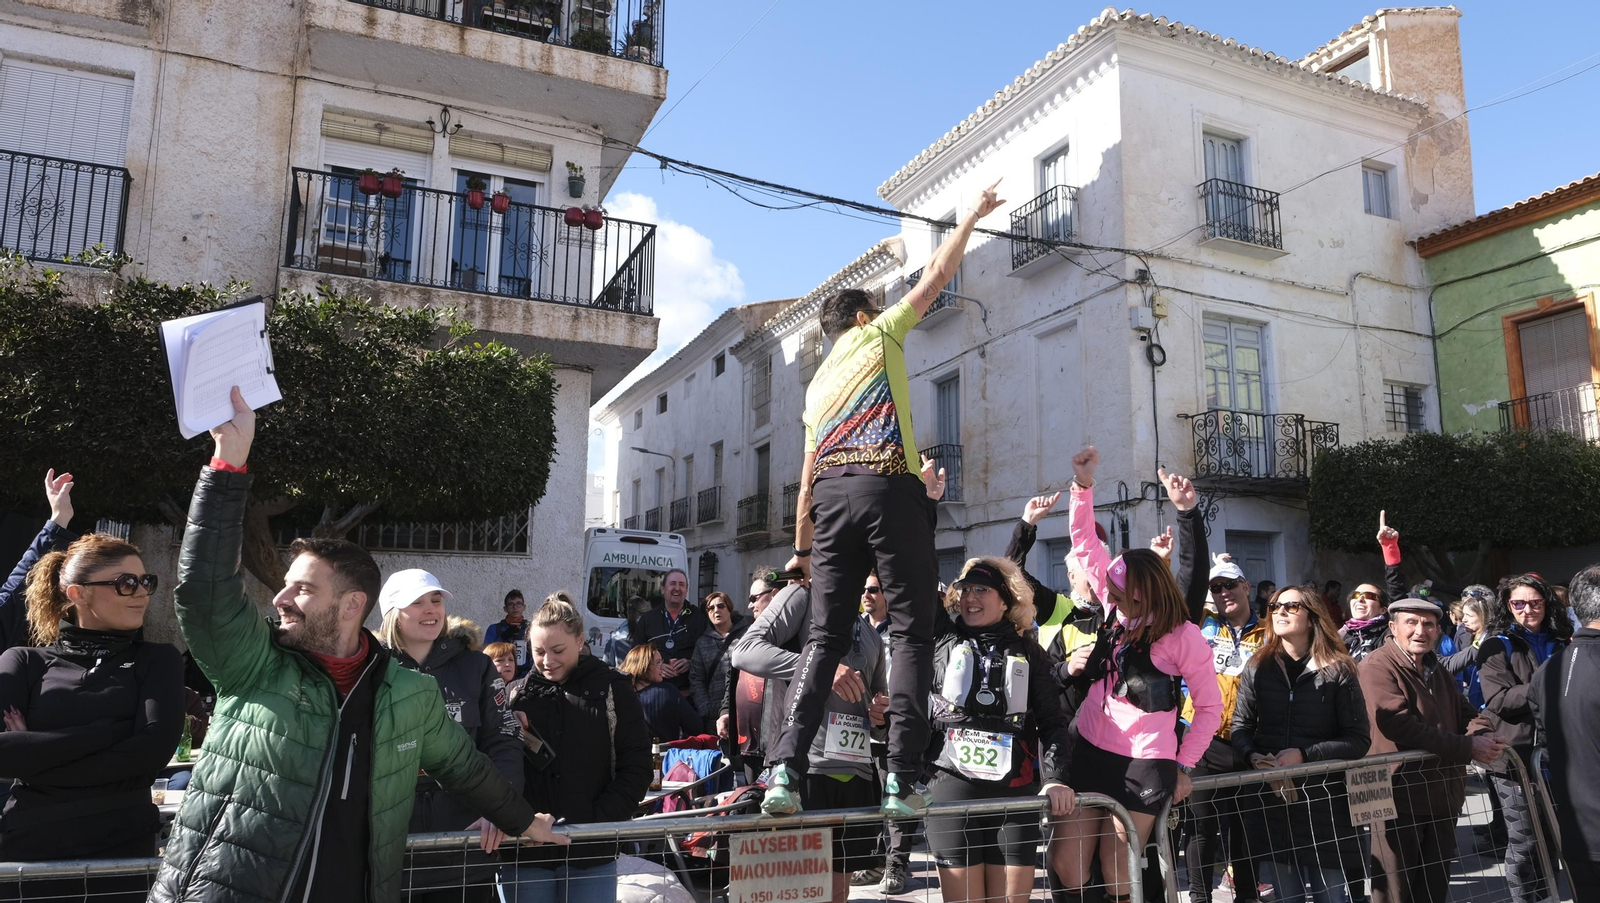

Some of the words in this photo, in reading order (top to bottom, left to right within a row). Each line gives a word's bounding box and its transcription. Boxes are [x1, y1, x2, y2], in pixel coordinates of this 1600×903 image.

[603, 553, 673, 567] AMBULANCIA
[801, 643, 817, 679] VENTOS
[794, 682, 805, 700] NON
[788, 702, 798, 726] STOP
[839, 730, 866, 750] 372
[960, 745, 998, 767] 352
[1351, 770, 1377, 786] ALYSER
[1378, 769, 1388, 782] DE
[1349, 787, 1392, 806] MAQUINARIA
[1361, 811, 1371, 821] 950
[1372, 809, 1383, 819] 453
[1383, 807, 1394, 817] 550
[739, 835, 798, 855] ALYSER
[802, 832, 823, 850] DE
[731, 858, 829, 881] MAQUINARIA
[751, 891, 773, 902] 950
[777, 888, 798, 900] 453
[803, 886, 824, 898] 550
